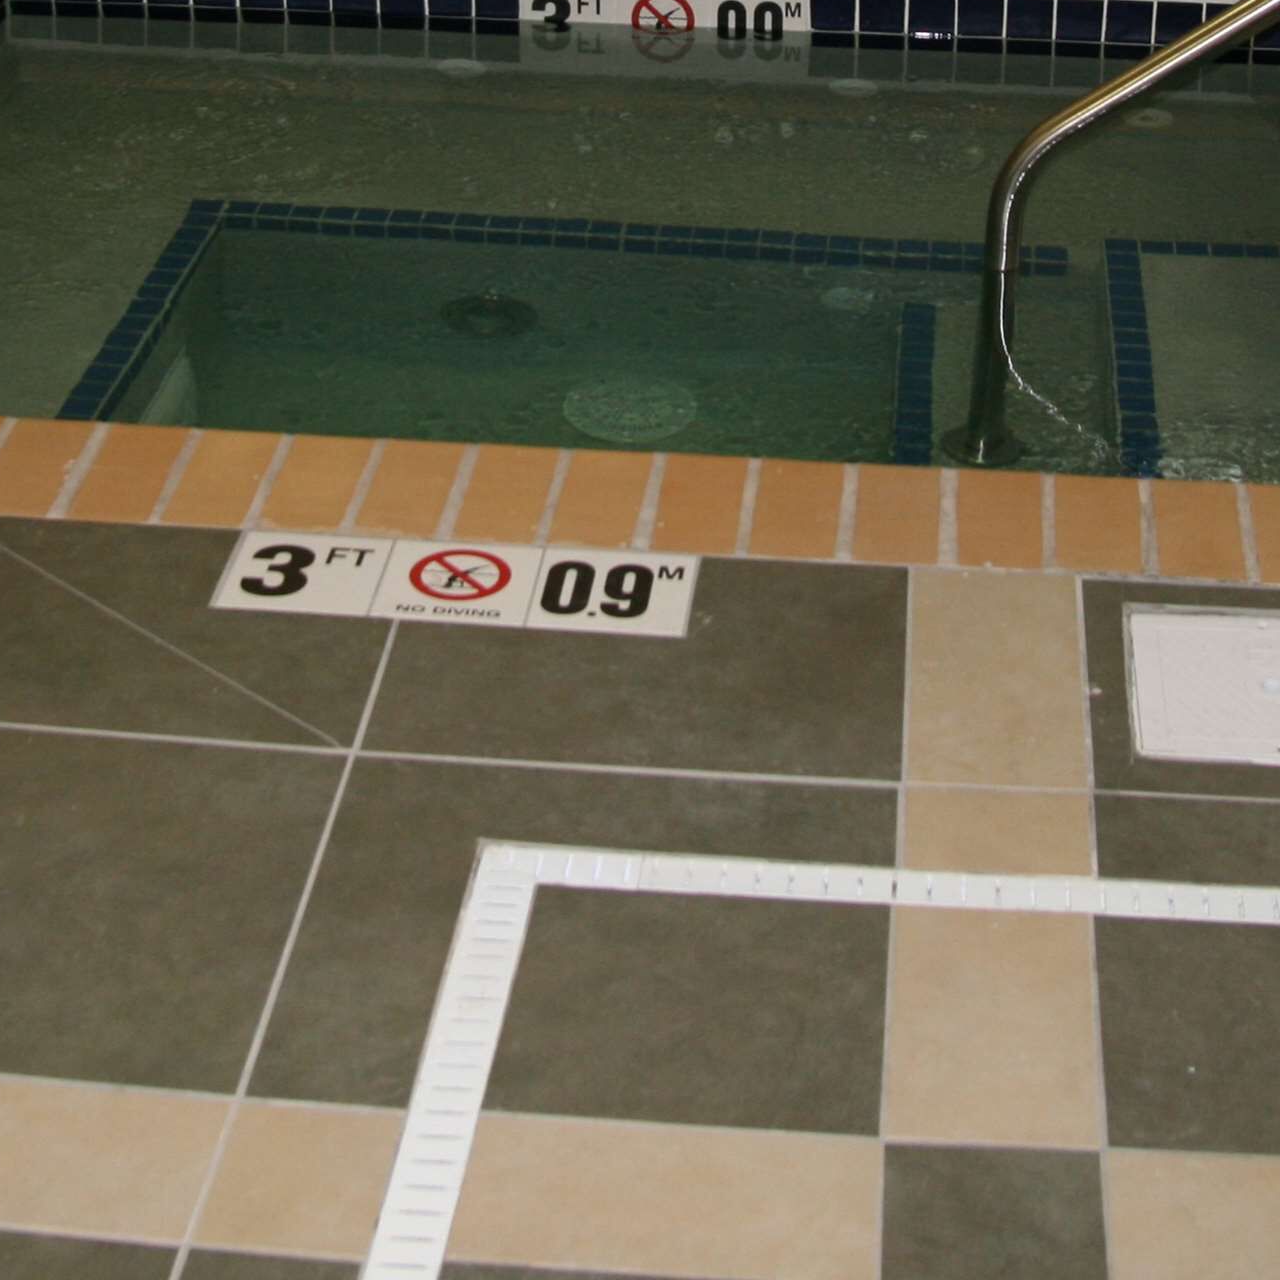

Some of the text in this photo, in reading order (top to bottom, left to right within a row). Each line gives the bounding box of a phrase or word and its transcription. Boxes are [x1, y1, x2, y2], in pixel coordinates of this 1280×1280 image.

[240, 544, 376, 597] 3 FT
[395, 604, 501, 618] NO DIVING
